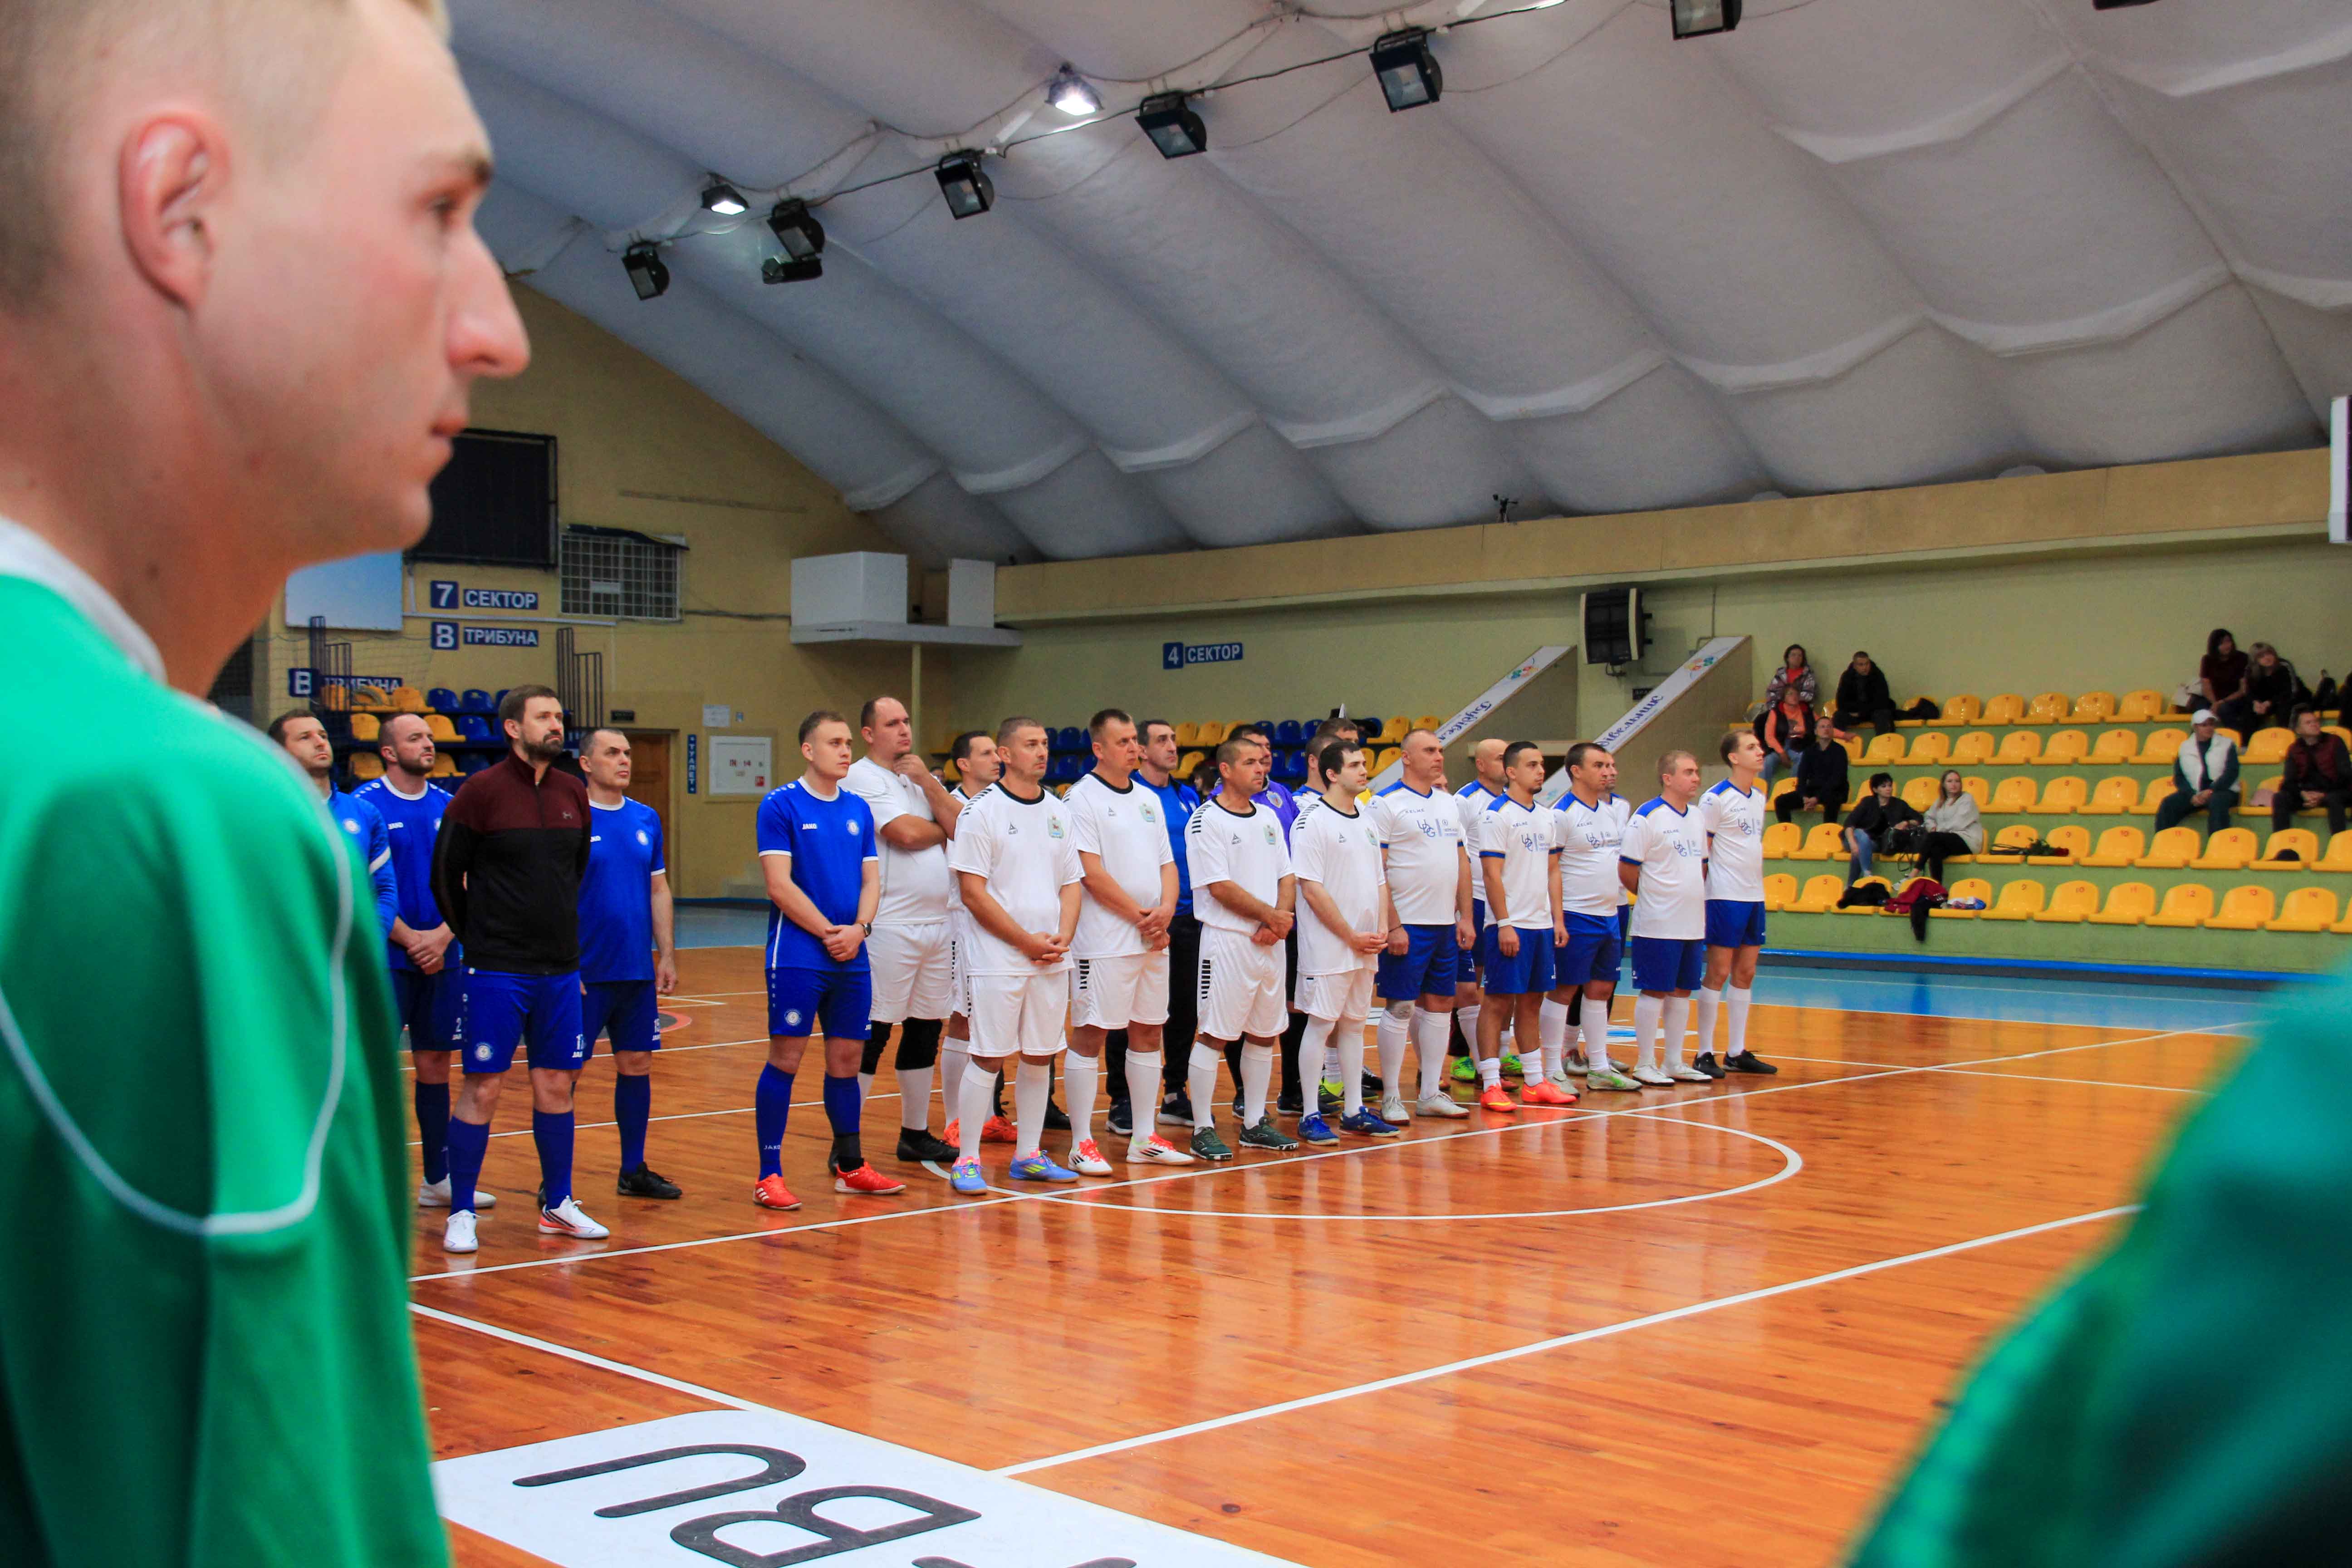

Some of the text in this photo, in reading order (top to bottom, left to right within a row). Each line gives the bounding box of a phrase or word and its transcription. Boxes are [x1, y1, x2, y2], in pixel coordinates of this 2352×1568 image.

[436, 584, 537, 608] 7 СЕКТОР
[464, 629, 538, 646] ТРИБУНА
[1168, 645, 1240, 665] 4 СЕКТОР
[1597, 695, 1664, 747] дівельник
